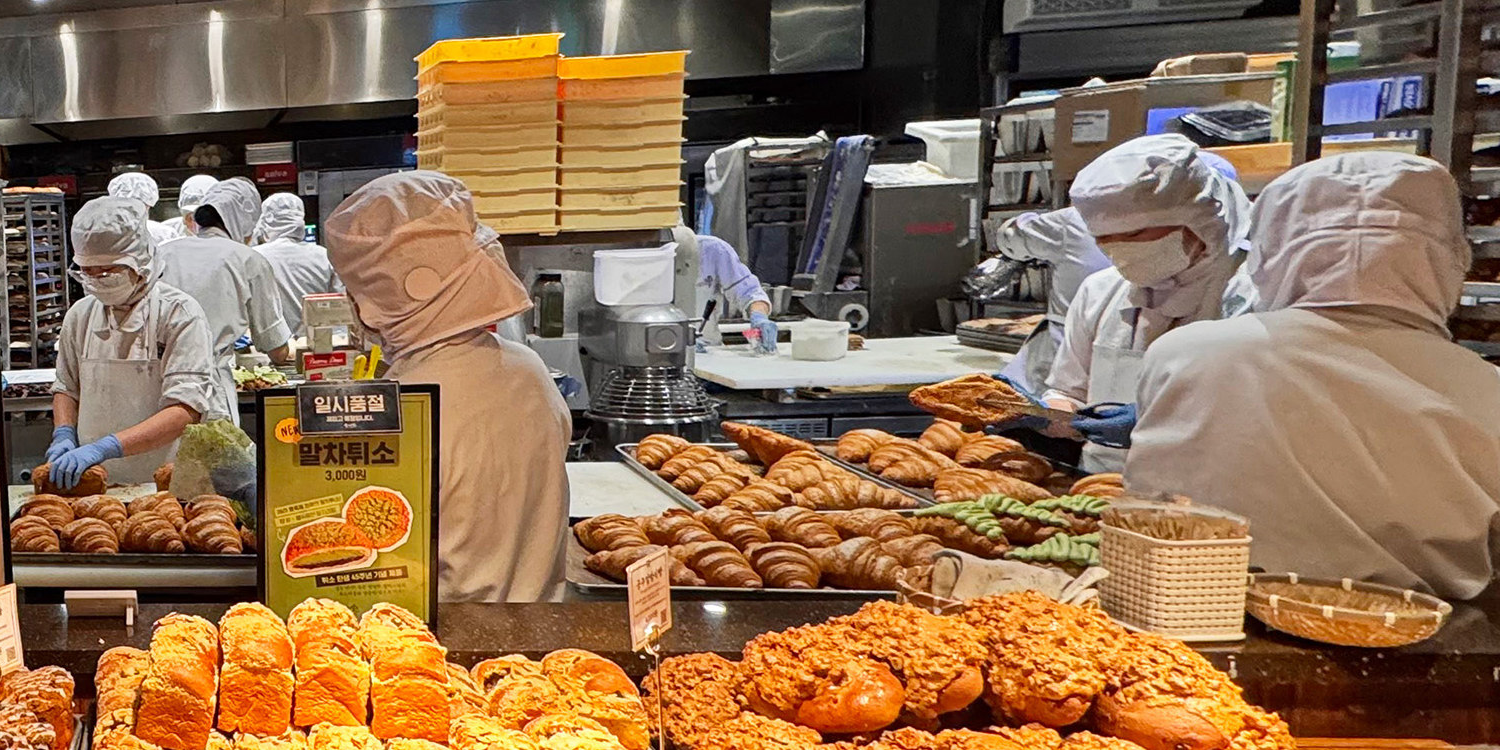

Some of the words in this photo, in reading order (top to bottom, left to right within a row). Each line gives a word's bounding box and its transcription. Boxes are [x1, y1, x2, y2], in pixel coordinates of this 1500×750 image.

[314, 394, 386, 414] 일시품절
[299, 441, 395, 466] 말차튀소
[325, 469, 366, 481] 3,000원
